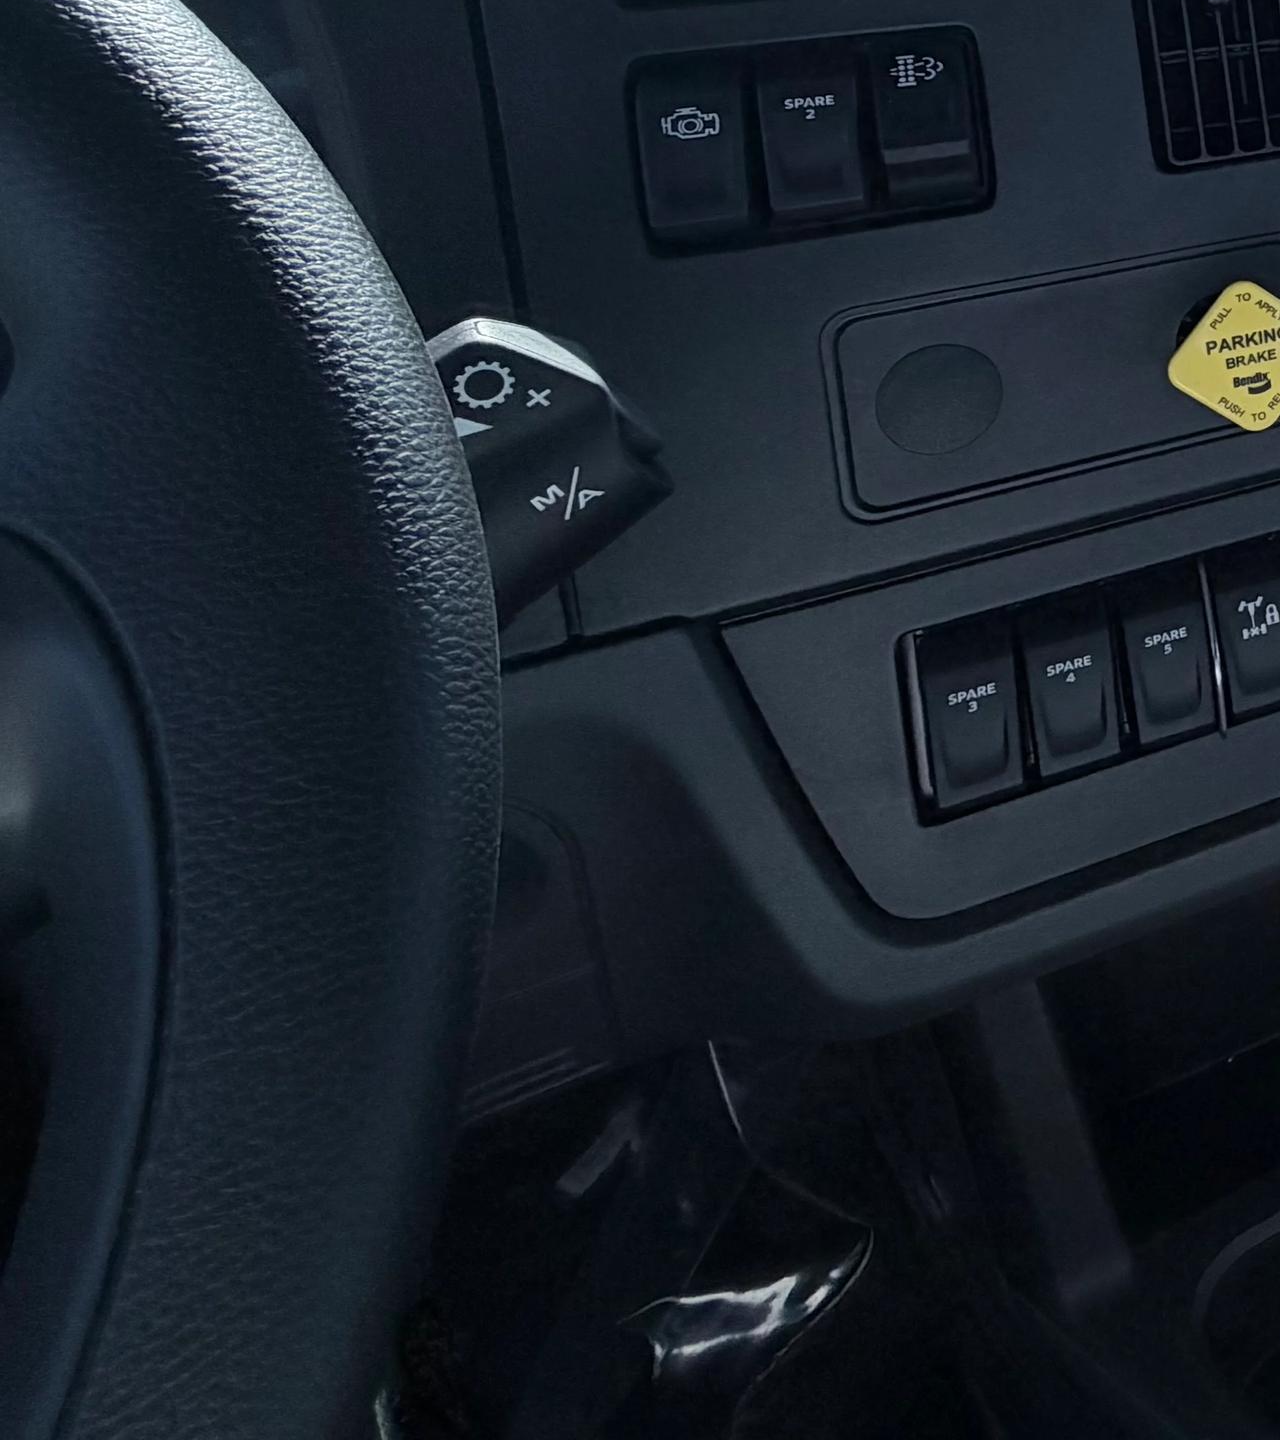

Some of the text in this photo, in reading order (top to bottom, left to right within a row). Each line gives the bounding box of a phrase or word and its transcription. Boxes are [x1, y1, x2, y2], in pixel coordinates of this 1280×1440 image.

[784, 94, 835, 110] SPARE
[805, 109, 816, 120] 2
[1209, 307, 1233, 330] PULL
[1235, 292, 1252, 302] TO
[1225, 348, 1277, 370] BRAKE
[1233, 371, 1270, 388] Bendix
[1217, 396, 1246, 417] PUSH
[1251, 411, 1267, 423] TO
[1144, 626, 1188, 648] SPARE
[1163, 643, 1173, 655] 5
[1046, 655, 1093, 678] SPARE
[1065, 672, 1076, 683] 4
[948, 682, 997, 706] SPARE
[967, 700, 978, 713] 3
